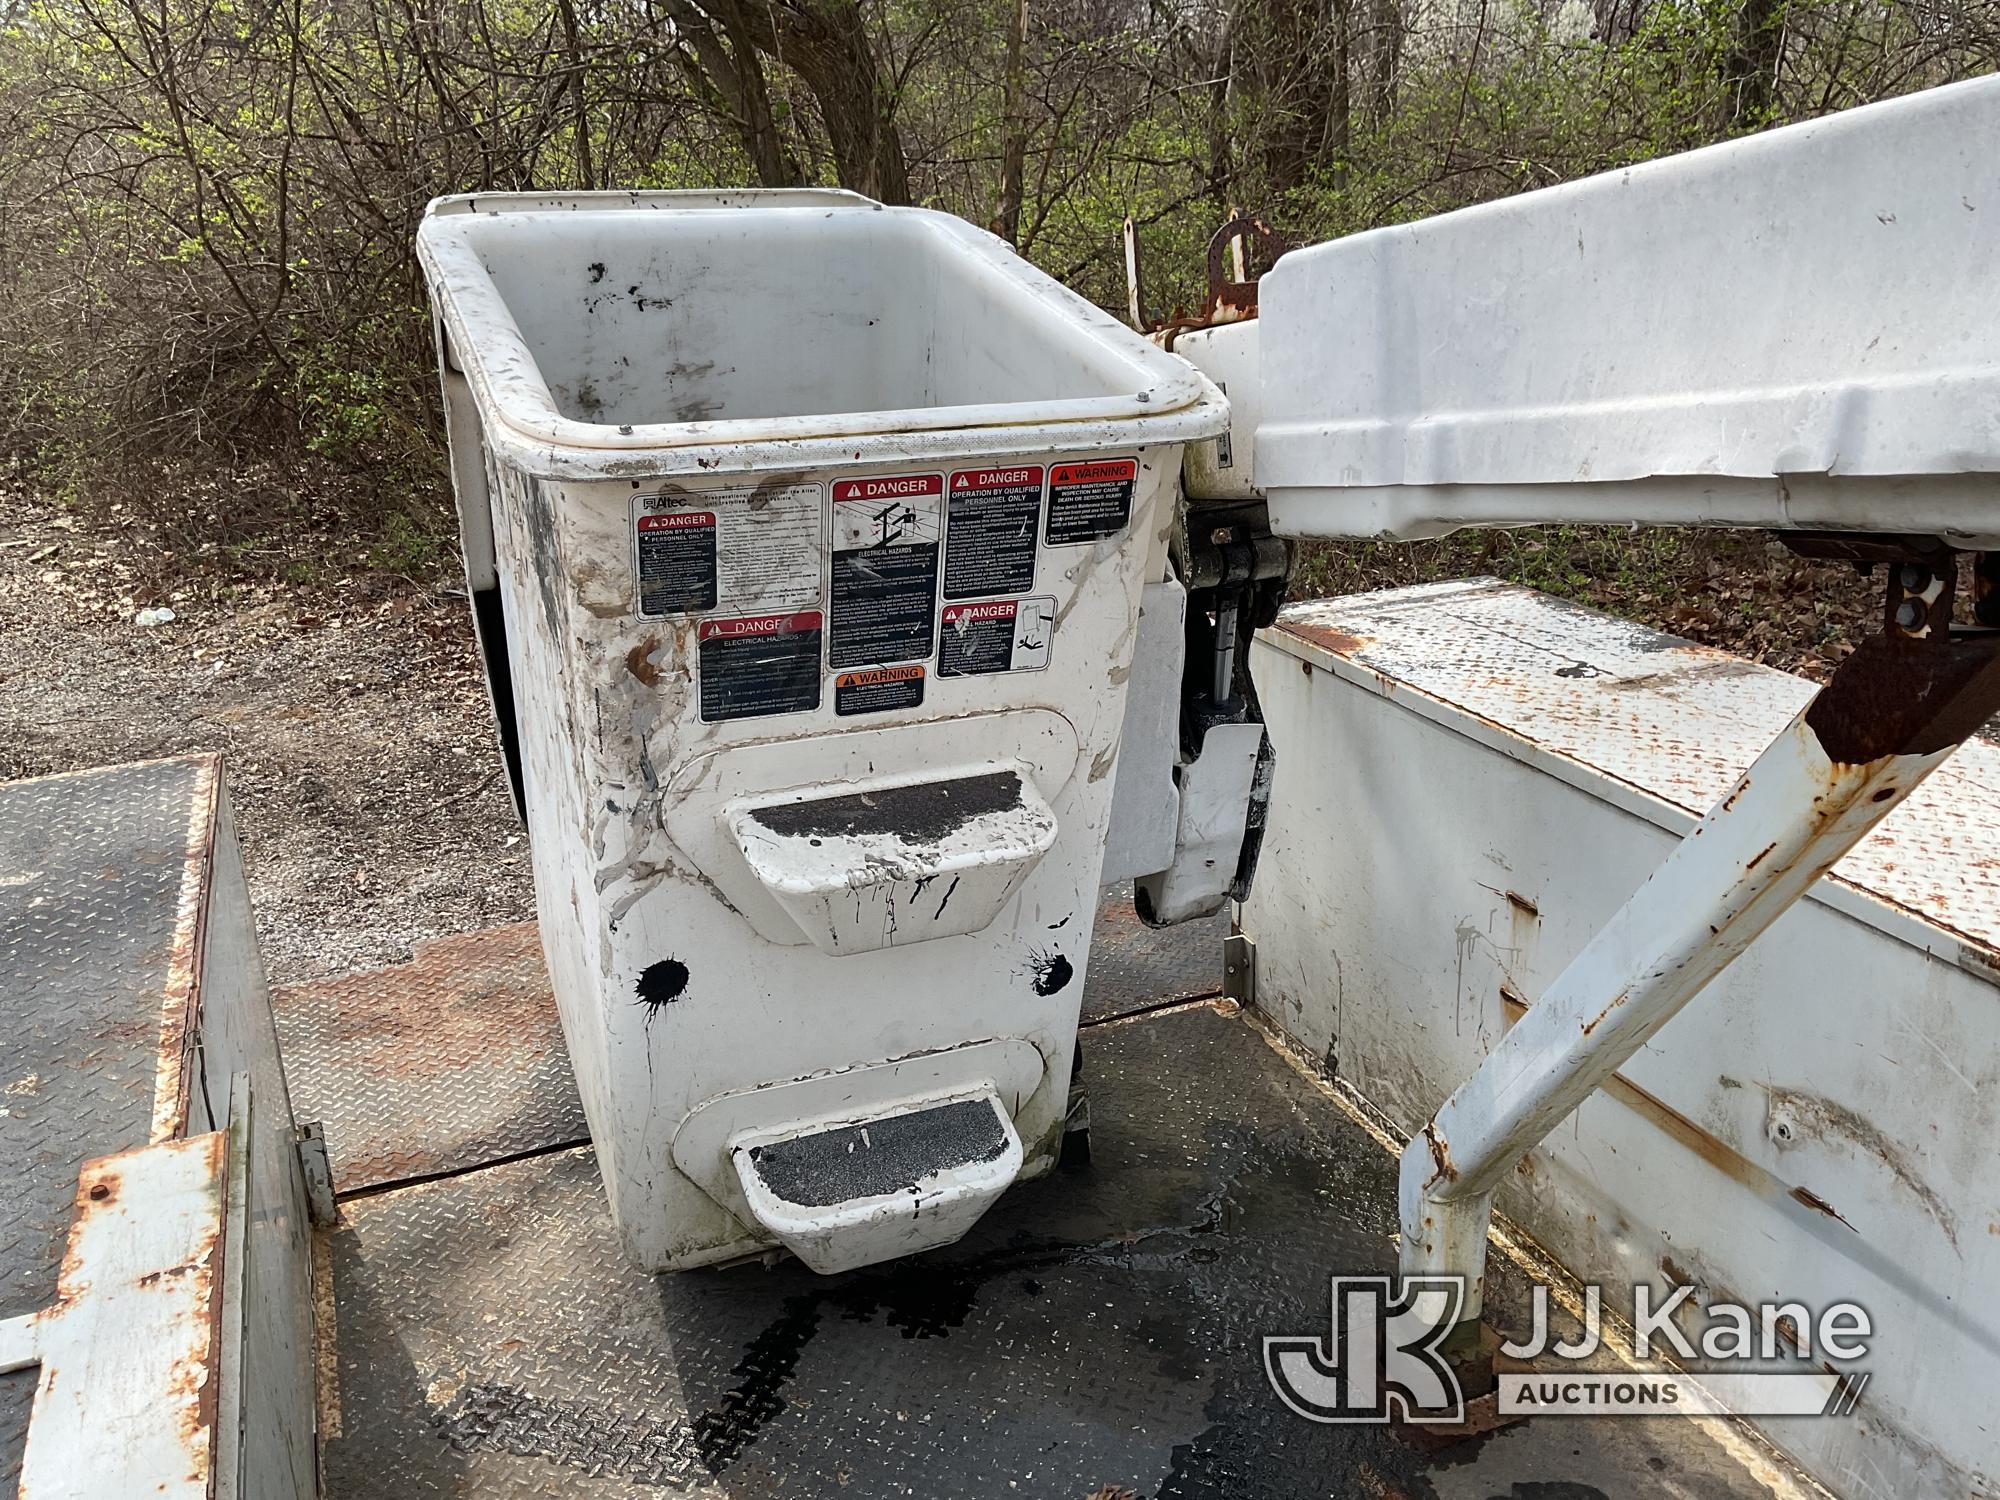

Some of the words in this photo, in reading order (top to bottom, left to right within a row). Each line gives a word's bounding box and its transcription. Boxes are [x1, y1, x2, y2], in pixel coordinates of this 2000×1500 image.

[979, 471, 1028, 485] DANGER
[1075, 466, 1127, 479] WARNING
[867, 480, 927, 495] DANGER
[952, 489, 991, 499] OPERATION
[1003, 485, 1039, 494] QUALIFIED
[656, 496, 686, 508] Altec
[965, 497, 1005, 505] PERSONNEL
[661, 516, 705, 526] DANGER
[858, 549, 887, 558] ELECTRICAL
[888, 547, 911, 555] HAZARDS
[735, 618, 792, 633] DANGER
[724, 637, 764, 647] ELECTRICAL
[766, 634, 798, 643] HAZARDS
[859, 669, 918, 683] WARNING
